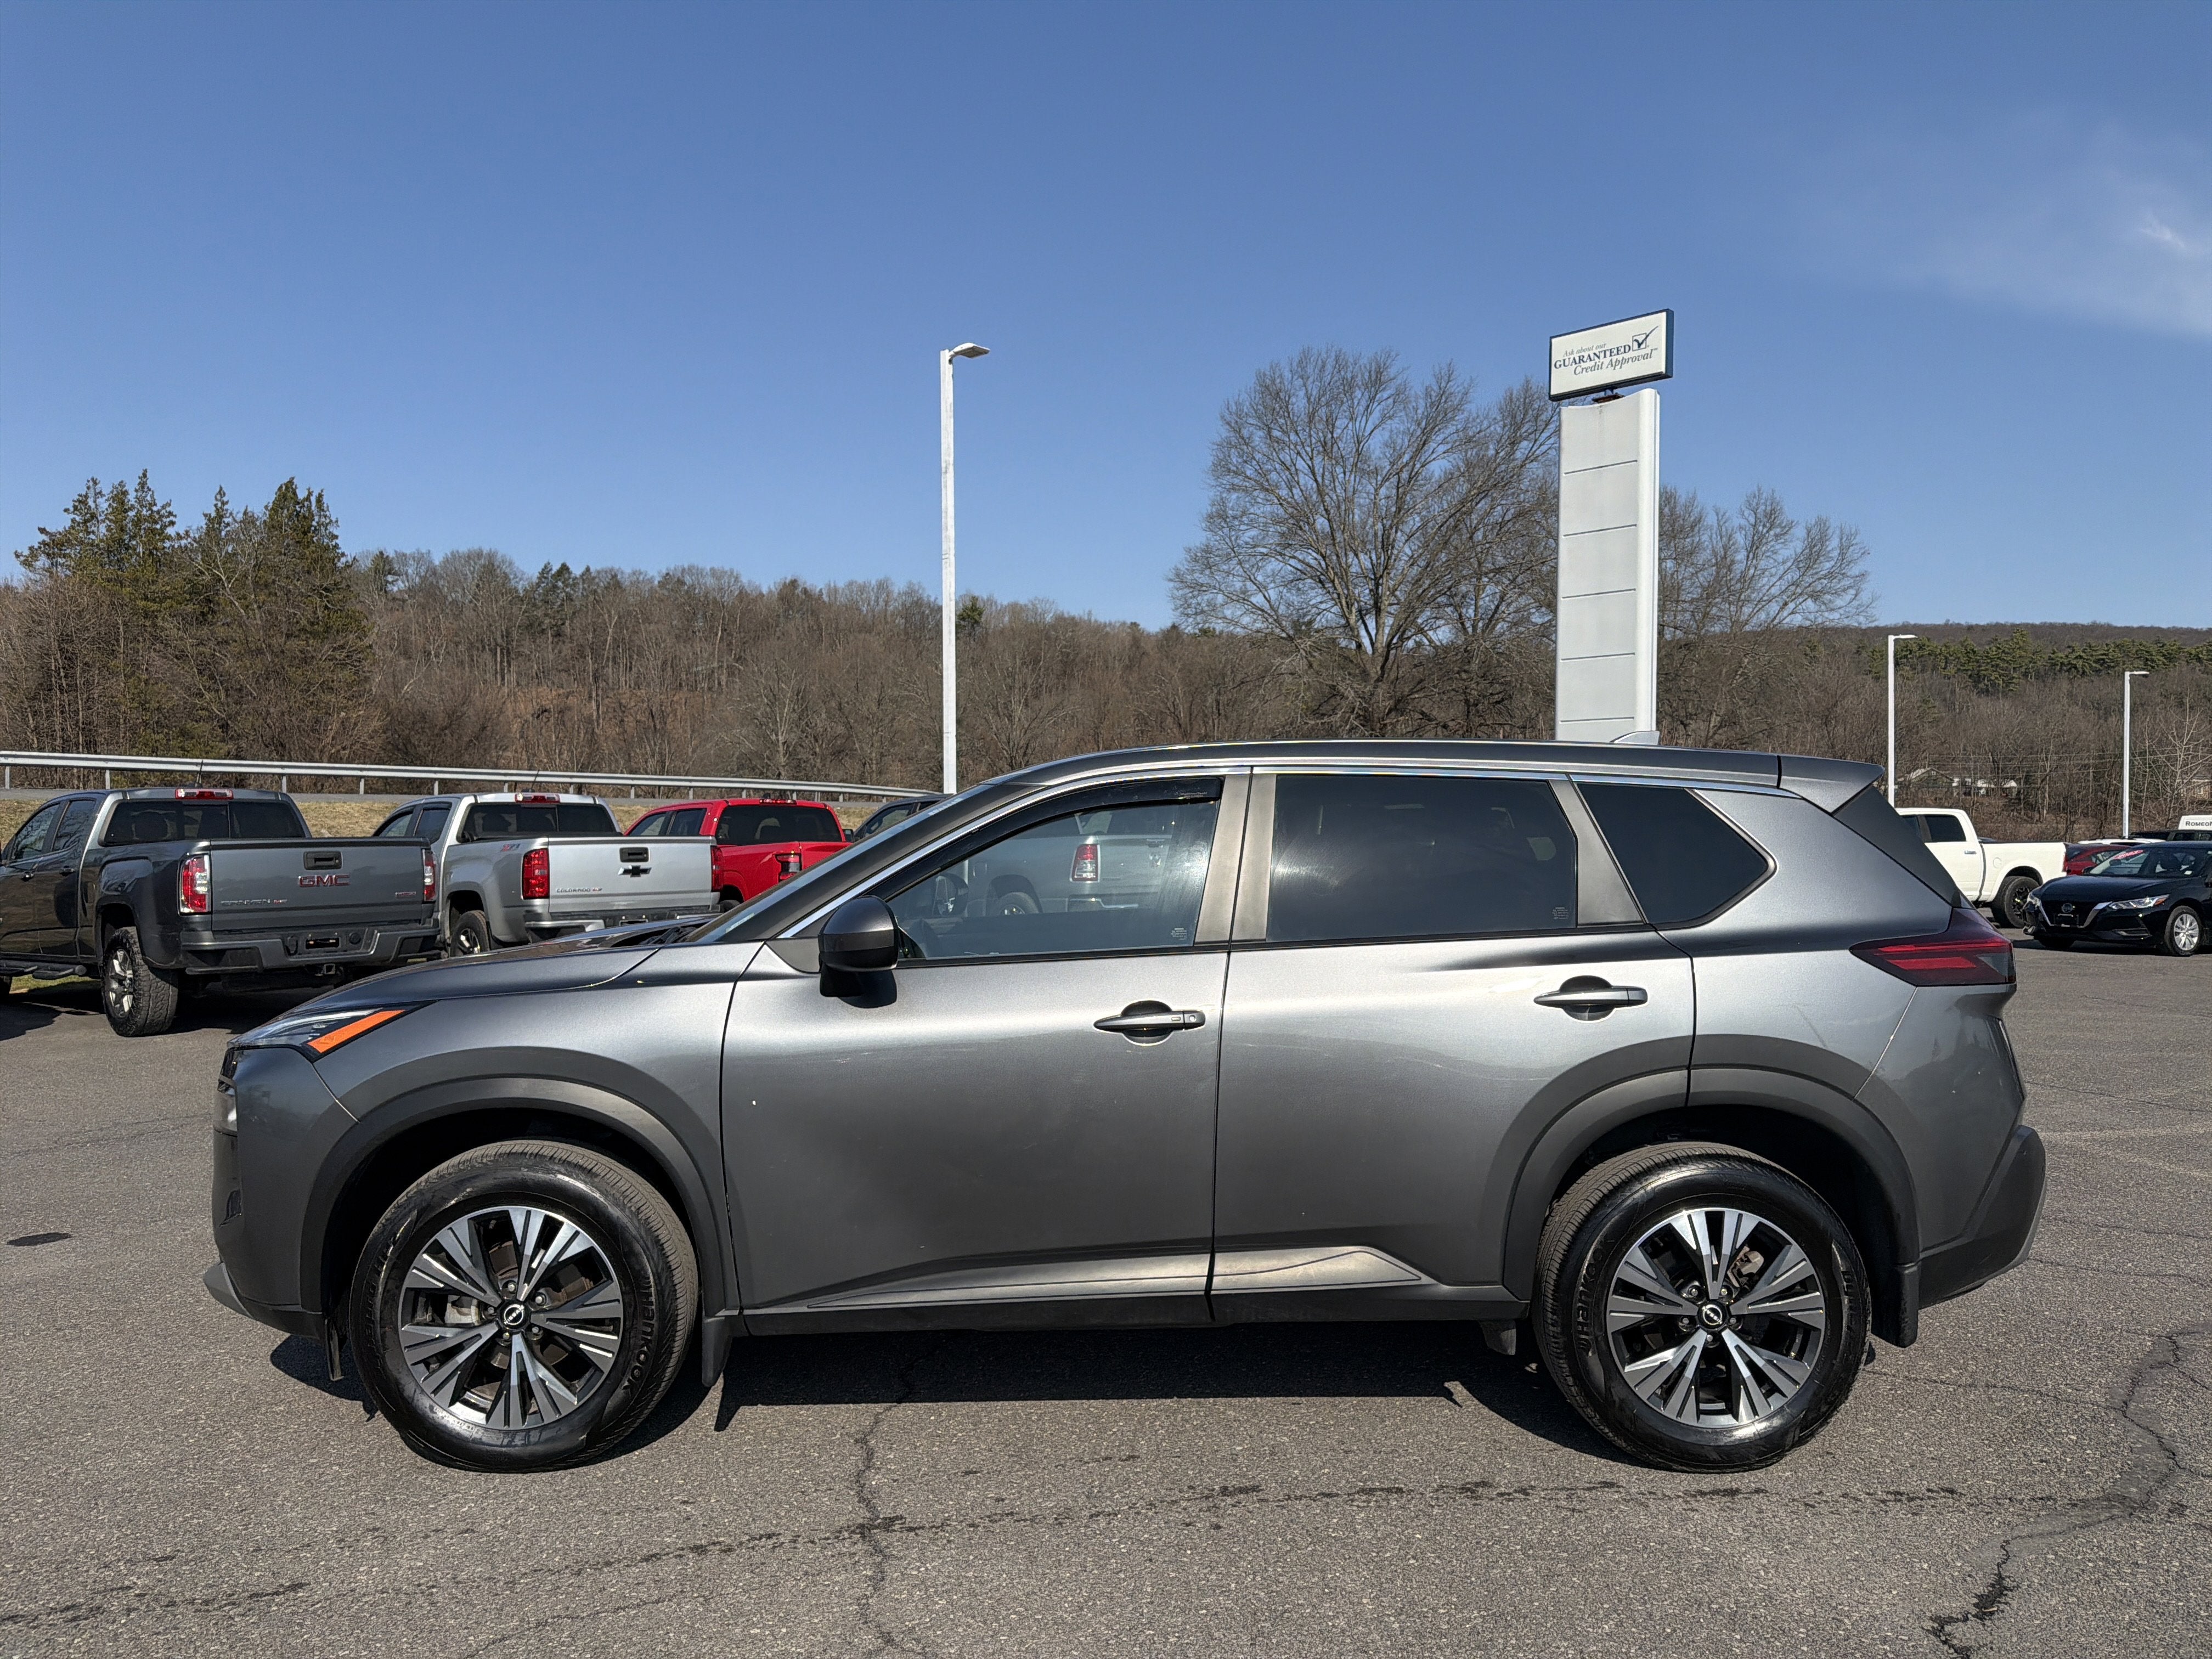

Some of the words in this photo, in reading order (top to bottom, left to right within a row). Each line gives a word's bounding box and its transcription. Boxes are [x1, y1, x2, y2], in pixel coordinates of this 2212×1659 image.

[1554, 345, 1631, 369] GUARANTEED
[1562, 348, 1575, 357] Ask
[1576, 345, 1594, 354] about
[1573, 360, 1604, 375] Credit
[298, 874, 350, 887] GMC
[622, 1289, 655, 1391] Hankook
